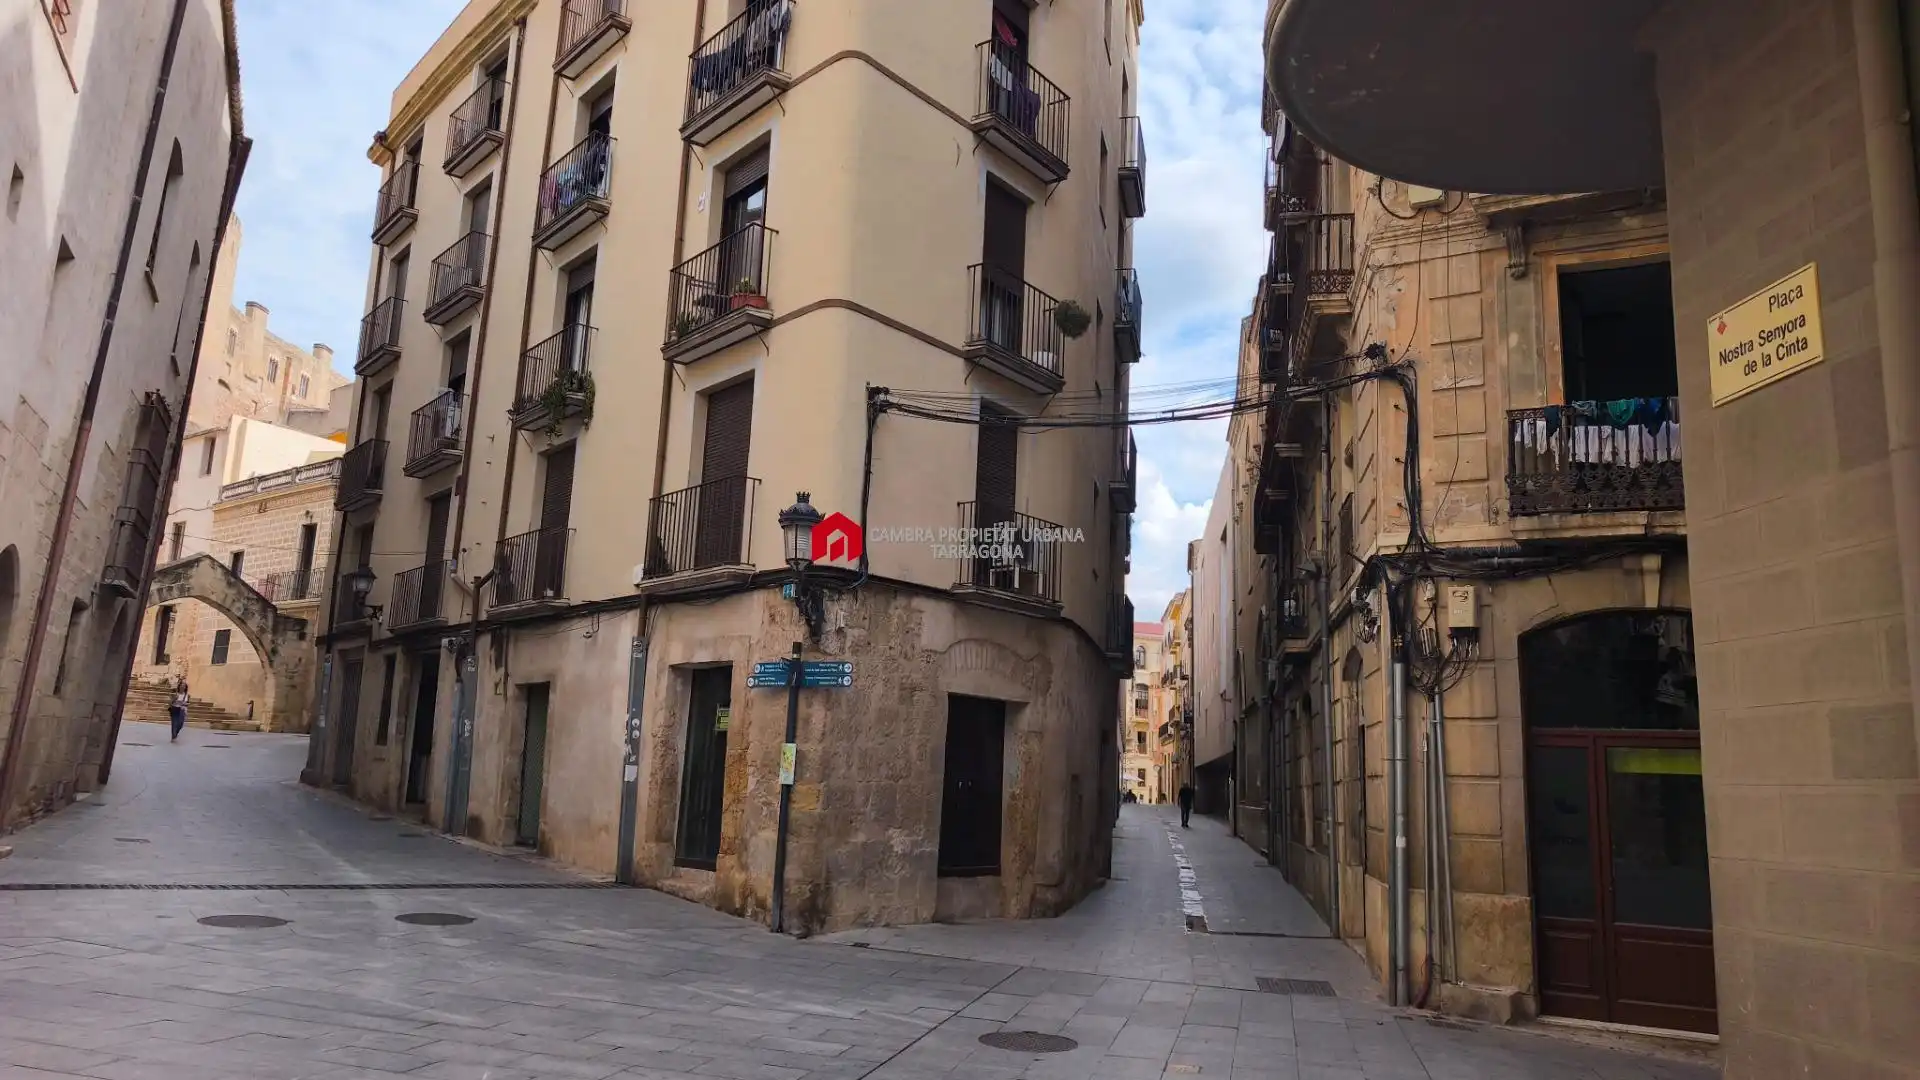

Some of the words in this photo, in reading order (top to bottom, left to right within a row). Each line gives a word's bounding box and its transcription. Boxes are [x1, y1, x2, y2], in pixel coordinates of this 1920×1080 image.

[1768, 284, 1804, 313] Plaça
[1718, 339, 1754, 366] Nostra
[1758, 314, 1806, 347] Senyora
[1743, 360, 1758, 376] de
[1761, 352, 1772, 367] la
[1775, 336, 1808, 361] Cinta
